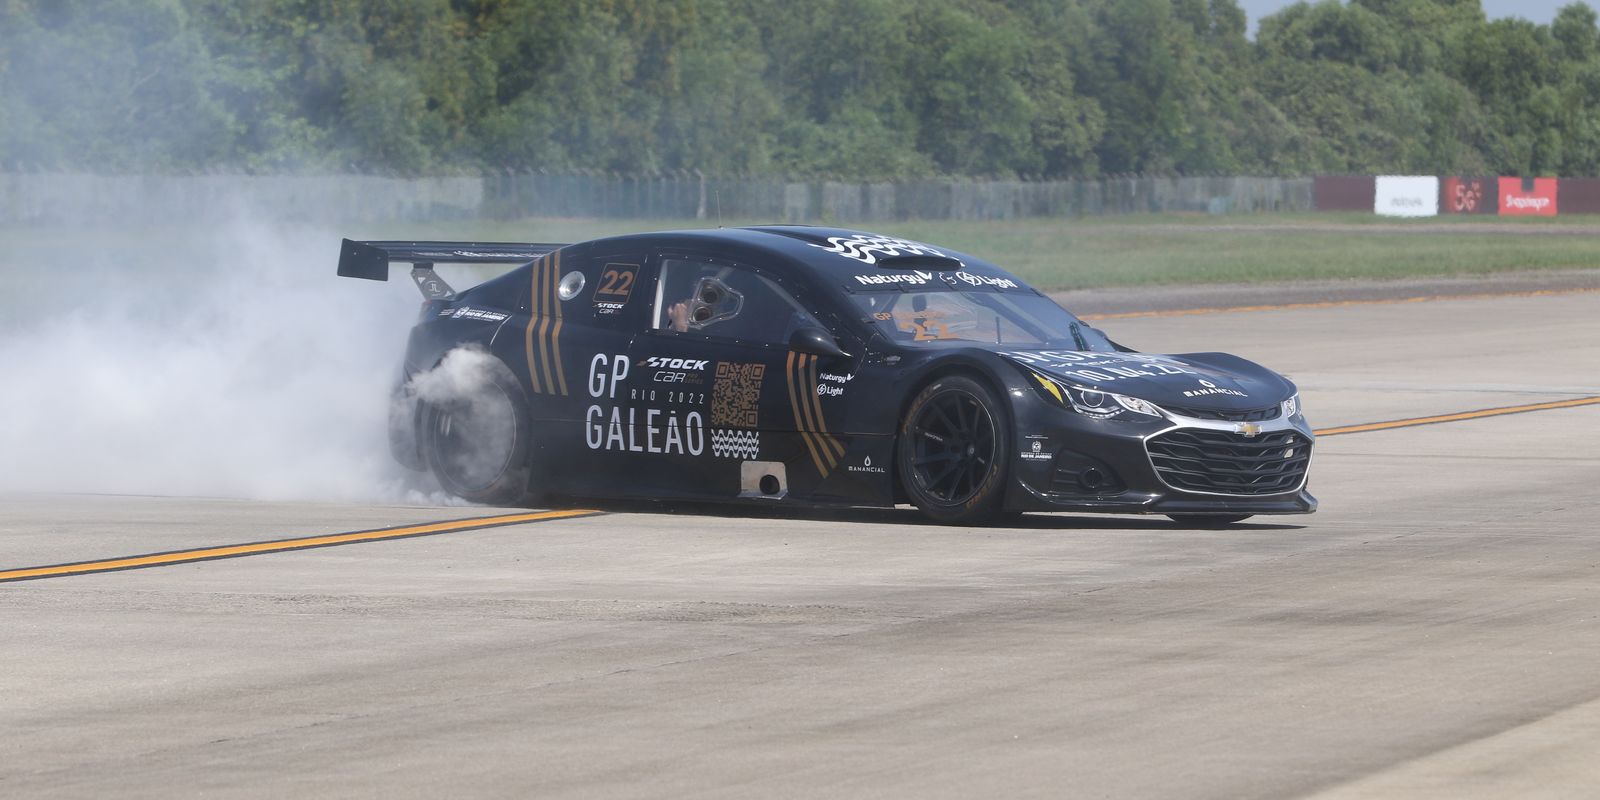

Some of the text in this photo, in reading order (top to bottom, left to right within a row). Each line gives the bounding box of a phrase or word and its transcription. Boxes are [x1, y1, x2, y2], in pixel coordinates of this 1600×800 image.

[597, 270, 634, 296] 22
[855, 272, 925, 285] Naturgy
[978, 275, 1018, 289] Light
[647, 356, 709, 371] STOCK
[588, 353, 630, 398] GP
[819, 372, 847, 384] Naturgy
[631, 388, 704, 405] RIO 2022
[826, 386, 844, 397] Light
[585, 404, 704, 456] GALEÃO
